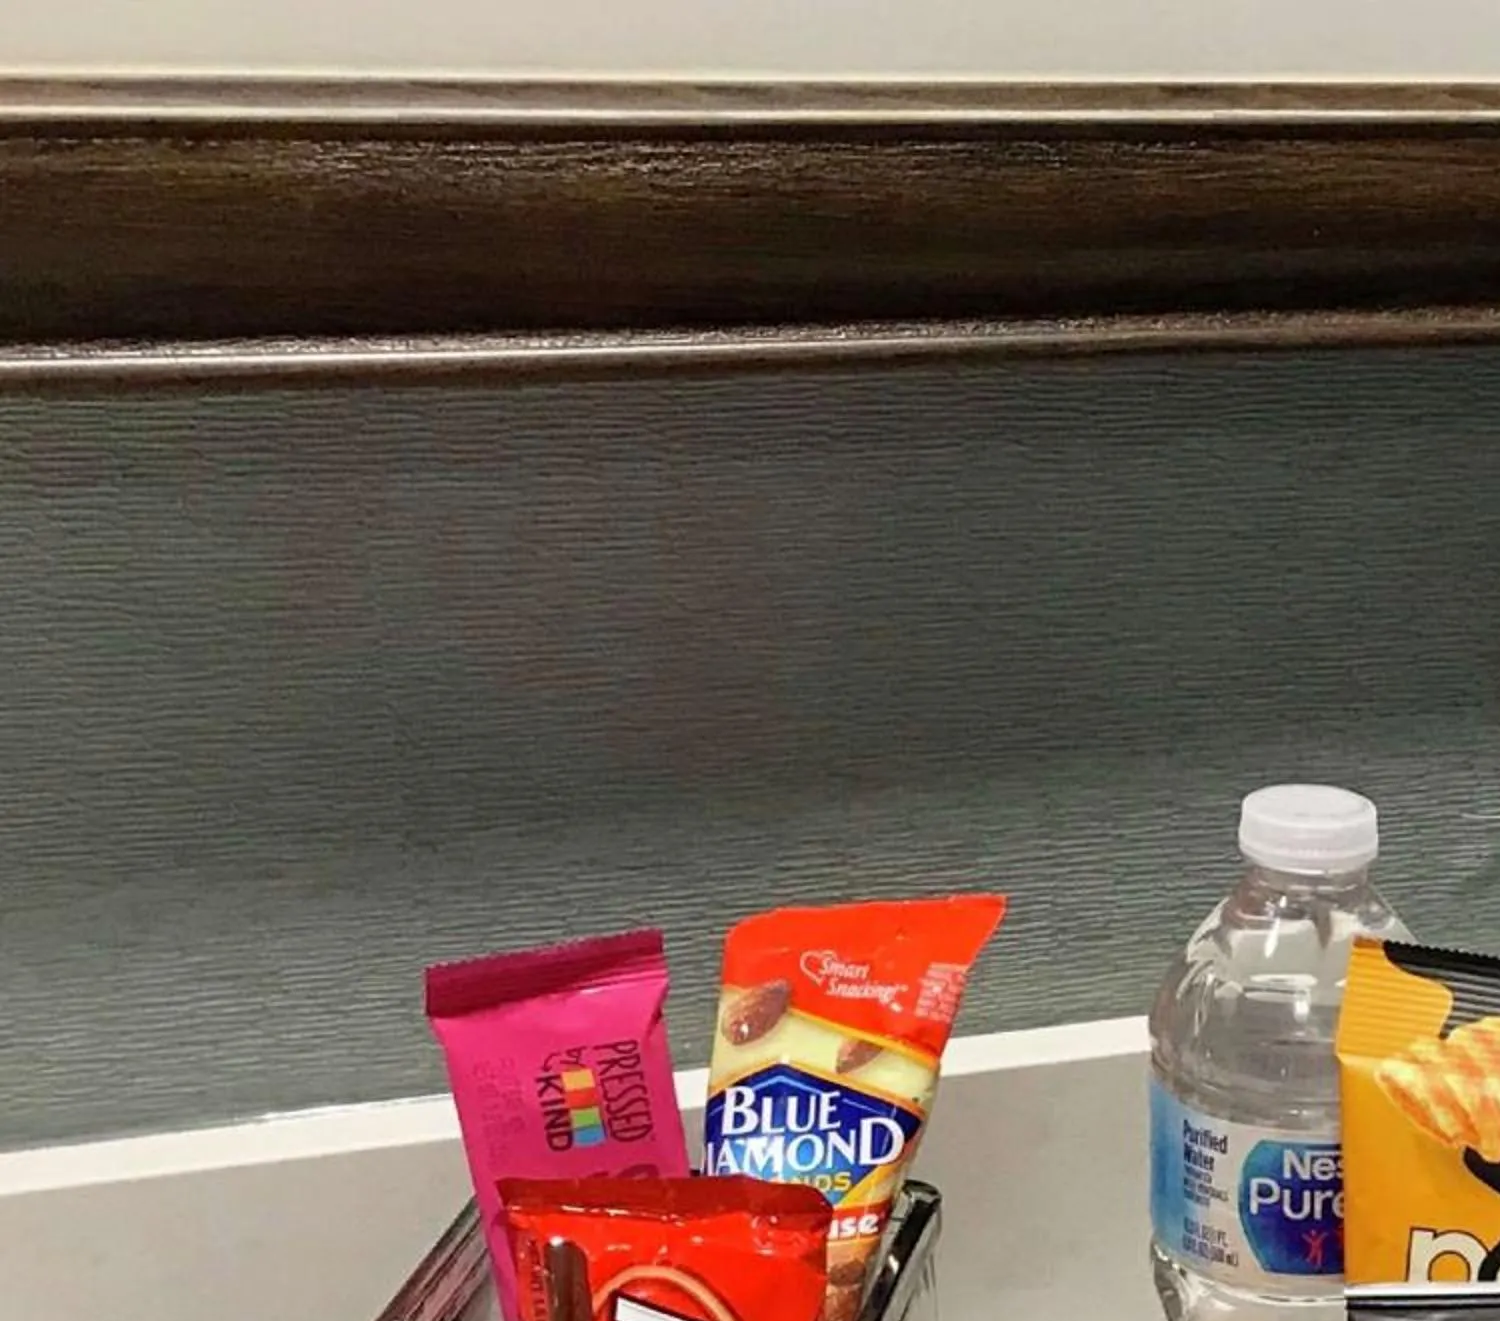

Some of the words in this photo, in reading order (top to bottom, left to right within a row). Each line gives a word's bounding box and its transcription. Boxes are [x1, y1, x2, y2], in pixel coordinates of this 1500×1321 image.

[819, 956, 871, 979] Smart
[534, 1074, 574, 1152] KIND
[592, 1039, 654, 1143] PRESSED
[721, 1085, 841, 1136] BLUE
[706, 1116, 905, 1182] IAMOND
